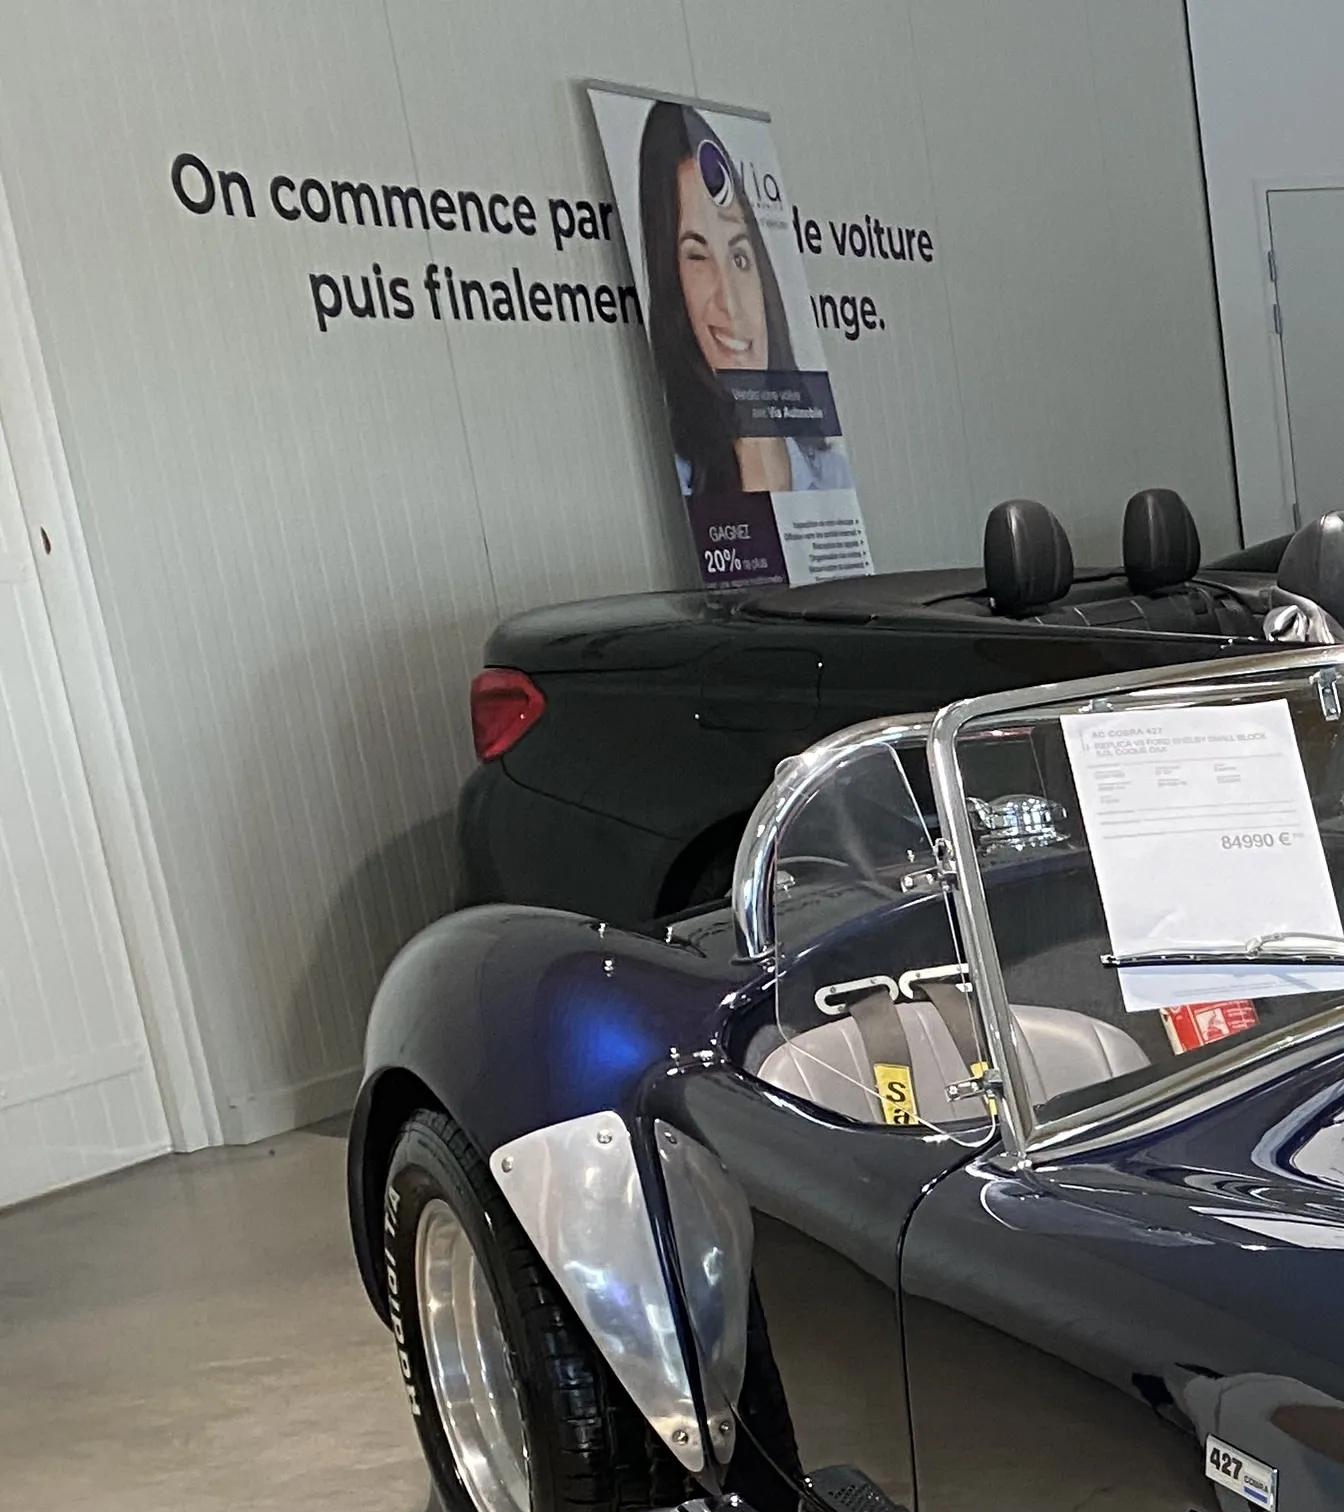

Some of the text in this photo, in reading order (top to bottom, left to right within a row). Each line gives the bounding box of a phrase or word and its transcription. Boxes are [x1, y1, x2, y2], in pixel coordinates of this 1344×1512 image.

[171, 153, 256, 218] On
[270, 175, 537, 236] commence
[549, 197, 612, 251] par
[829, 214, 934, 263] voiture
[308, 262, 414, 333] puis
[424, 263, 644, 325] finalemen
[708, 524, 751, 542] GAGNEZ
[705, 548, 741, 573] 20%
[1108, 728, 1143, 737] COBRA
[1094, 741, 1132, 750] REPLICA
[1221, 832, 1292, 849] 84990 €
[1210, 1447, 1243, 1480] 427
